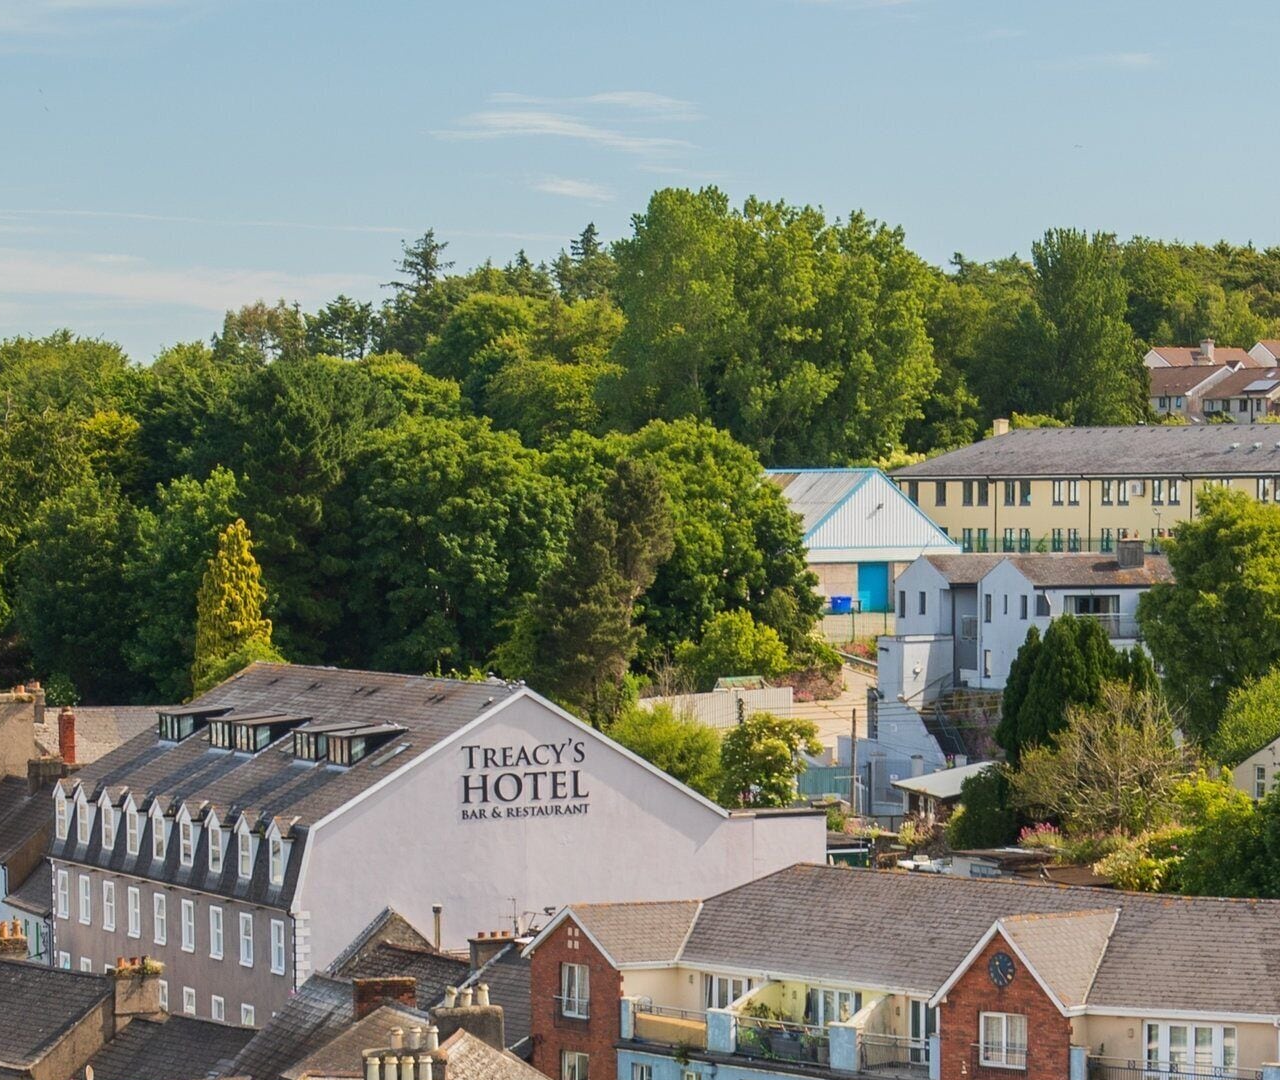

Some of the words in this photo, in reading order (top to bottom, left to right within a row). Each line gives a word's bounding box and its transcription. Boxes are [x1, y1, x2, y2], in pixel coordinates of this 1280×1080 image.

[461, 738, 586, 770] TREACY'S
[462, 770, 590, 804] HOTEL
[462, 808, 487, 820] BAR
[491, 806, 502, 819] &
[507, 804, 590, 818] RESTAURANT
